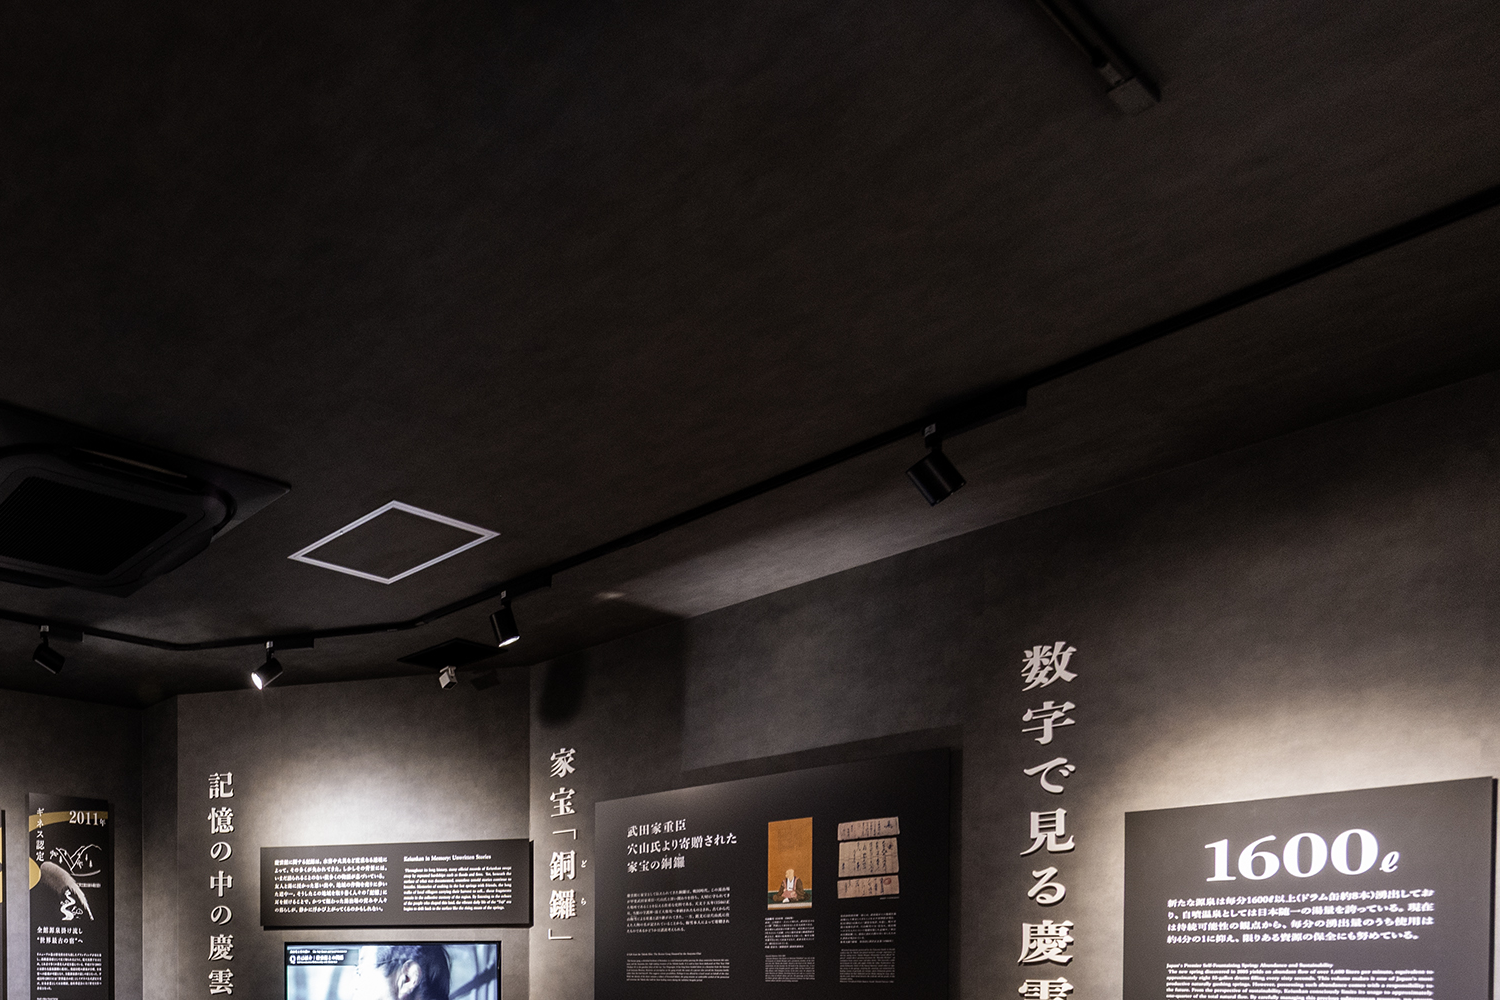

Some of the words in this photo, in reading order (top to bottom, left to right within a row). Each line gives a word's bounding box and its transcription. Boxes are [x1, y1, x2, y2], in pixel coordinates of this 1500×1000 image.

[68, 810, 106, 827] 2011年
[626, 818, 687, 838] 武田家重臣
[36, 808, 45, 862] ギネス認定
[548, 748, 577, 940] 家宝「銅鑼」
[626, 832, 738, 856] 穴山氏より寄贈された
[626, 855, 686, 874] 家宝の銅鑼
